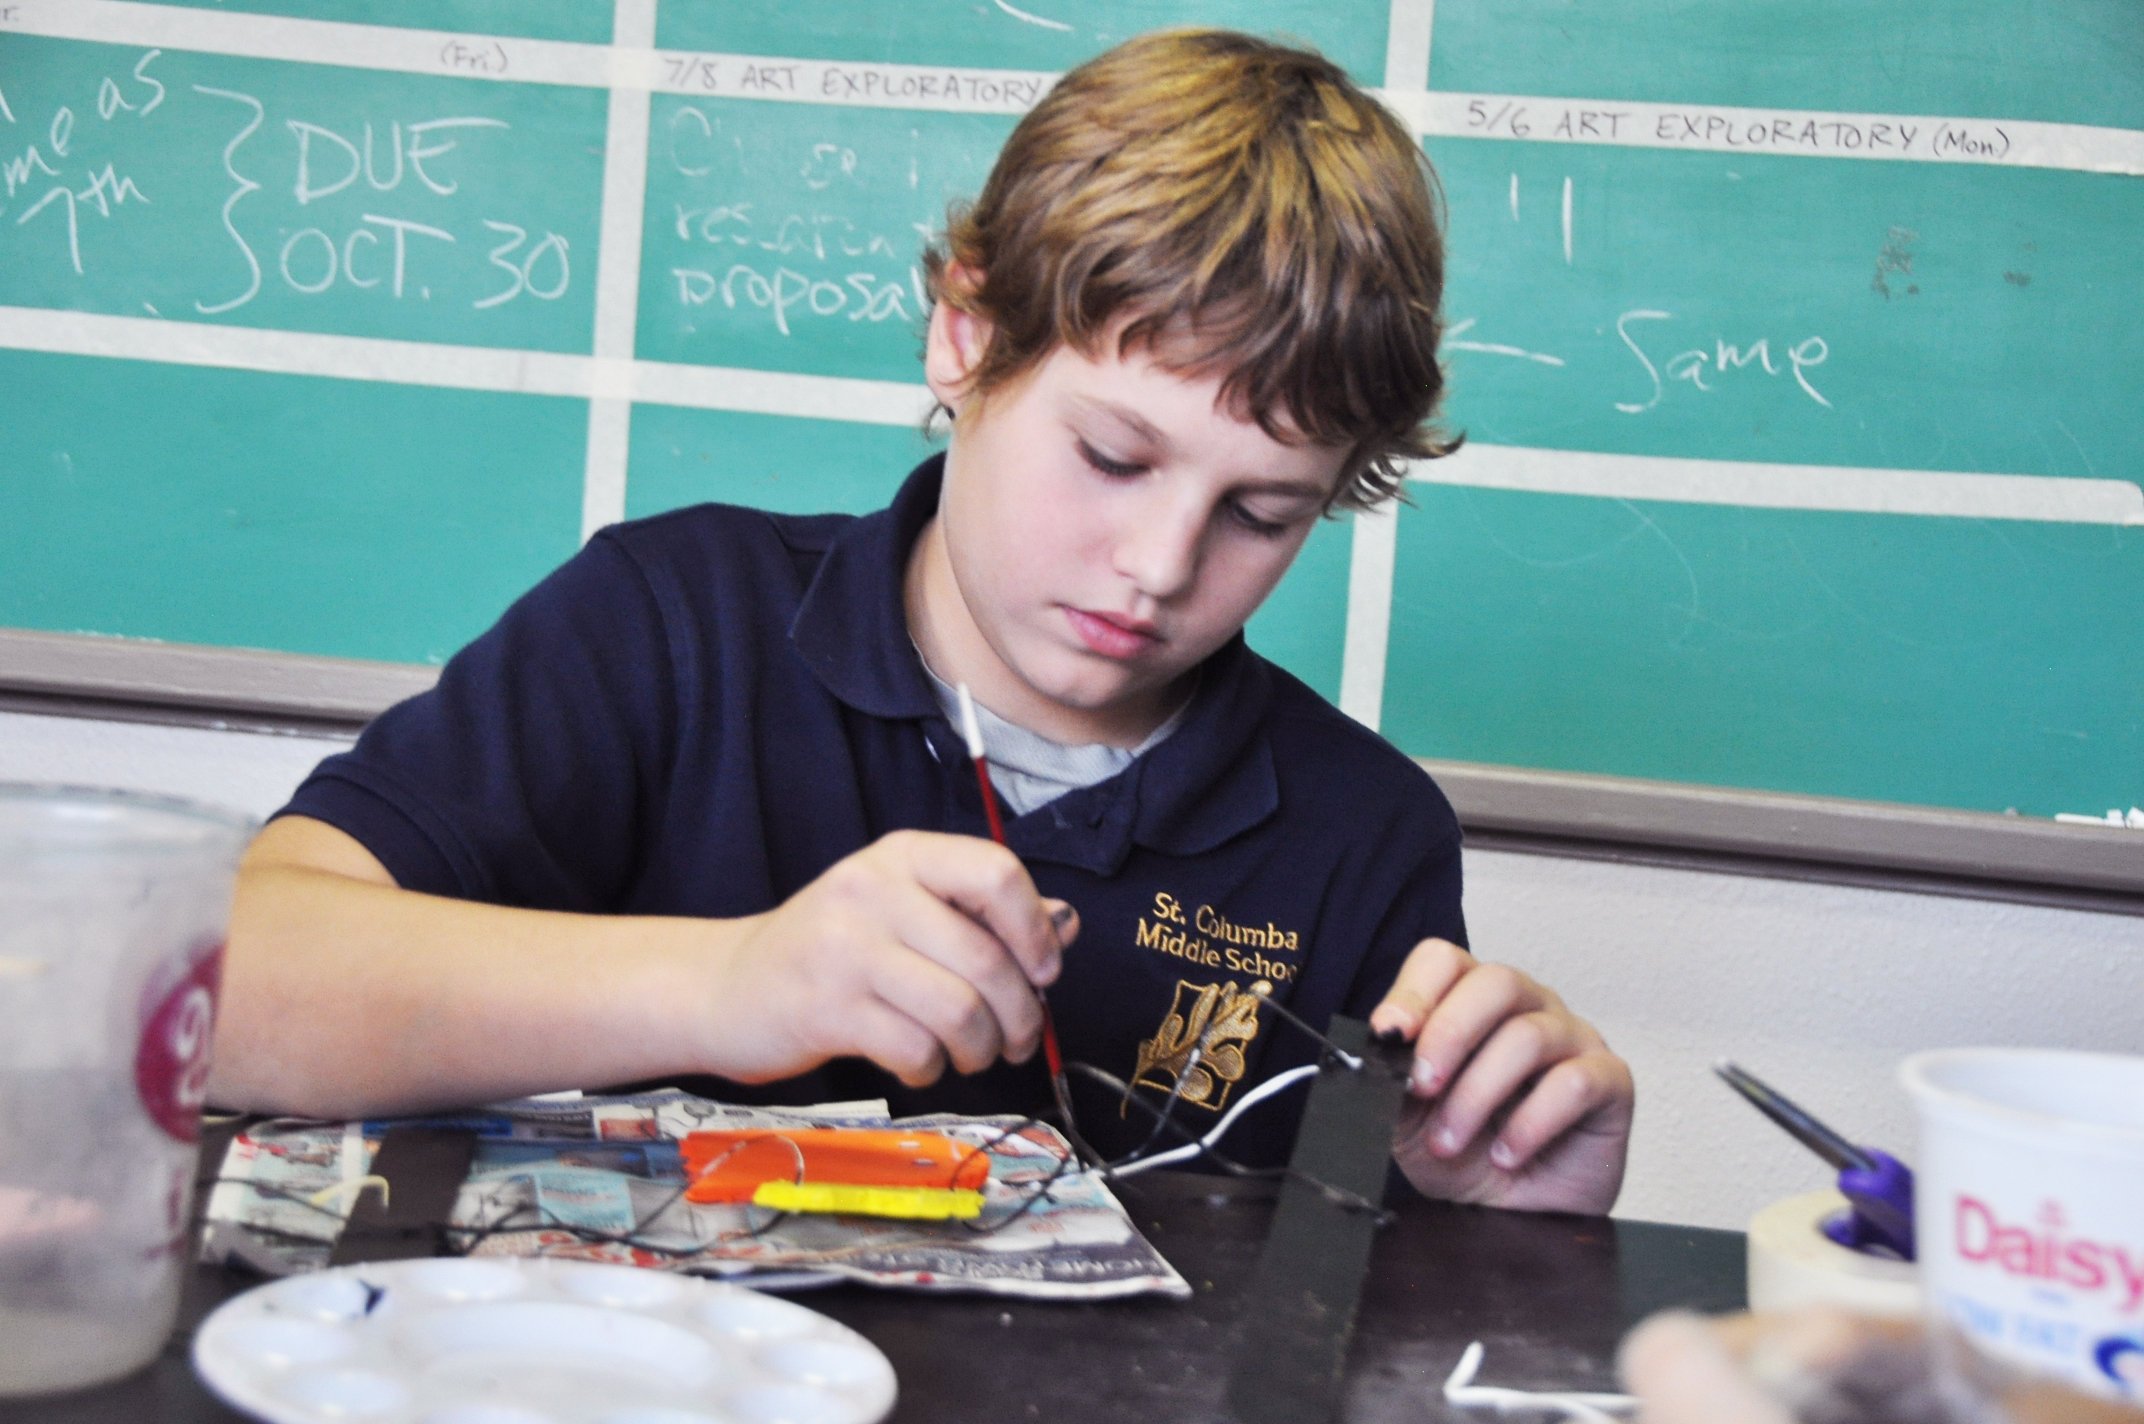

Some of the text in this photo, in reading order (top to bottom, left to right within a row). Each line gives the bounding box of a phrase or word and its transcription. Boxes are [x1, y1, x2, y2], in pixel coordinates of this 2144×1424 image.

[664, 58, 1044, 106] 7/8 ART EXPLORATORY
[1467, 100, 1531, 138] 5/6
[1555, 110, 1632, 139] ART
[1656, 113, 1918, 150] EXPLORATORY
[286, 116, 511, 204] DUE
[473, 218, 570, 308] 30
[1615, 309, 1834, 413] Same
[1135, 917, 1221, 968] Middle
[1152, 891, 1299, 951] St. Columba
